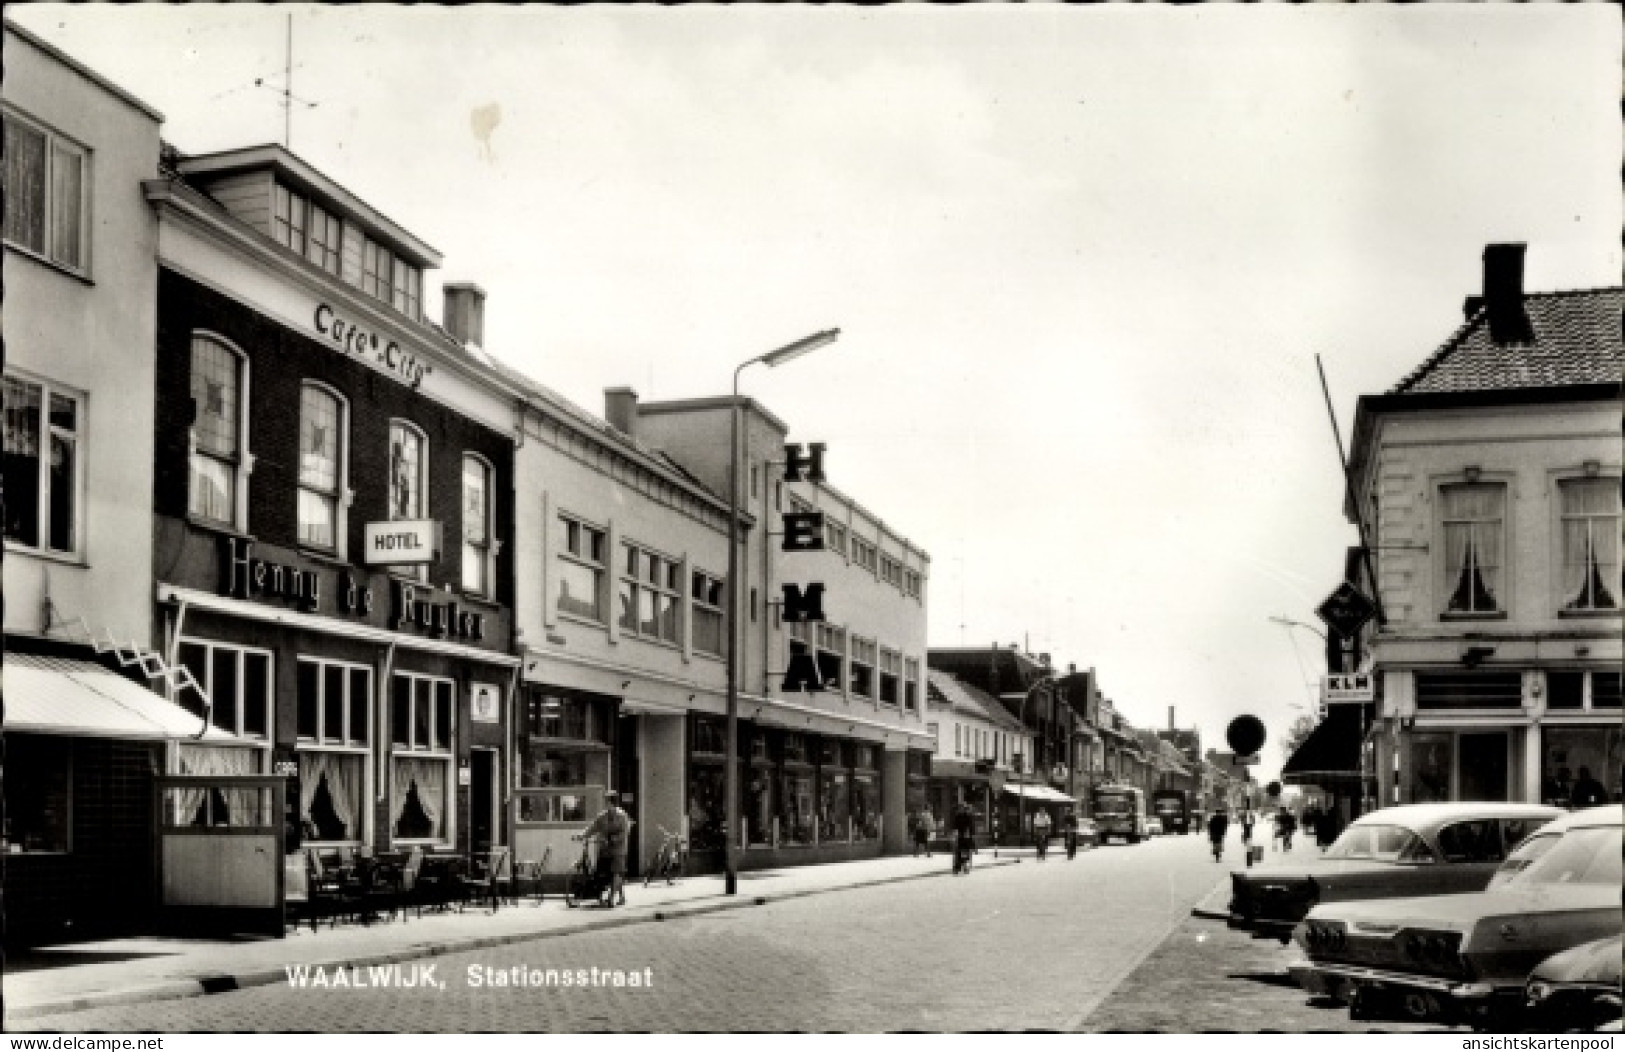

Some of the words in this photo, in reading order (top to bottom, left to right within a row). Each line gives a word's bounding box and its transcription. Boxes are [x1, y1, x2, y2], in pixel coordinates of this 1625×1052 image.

[226, 536, 321, 612] Henny
[374, 532, 424, 551] HOTEL
[781, 442, 826, 693] HEMA
